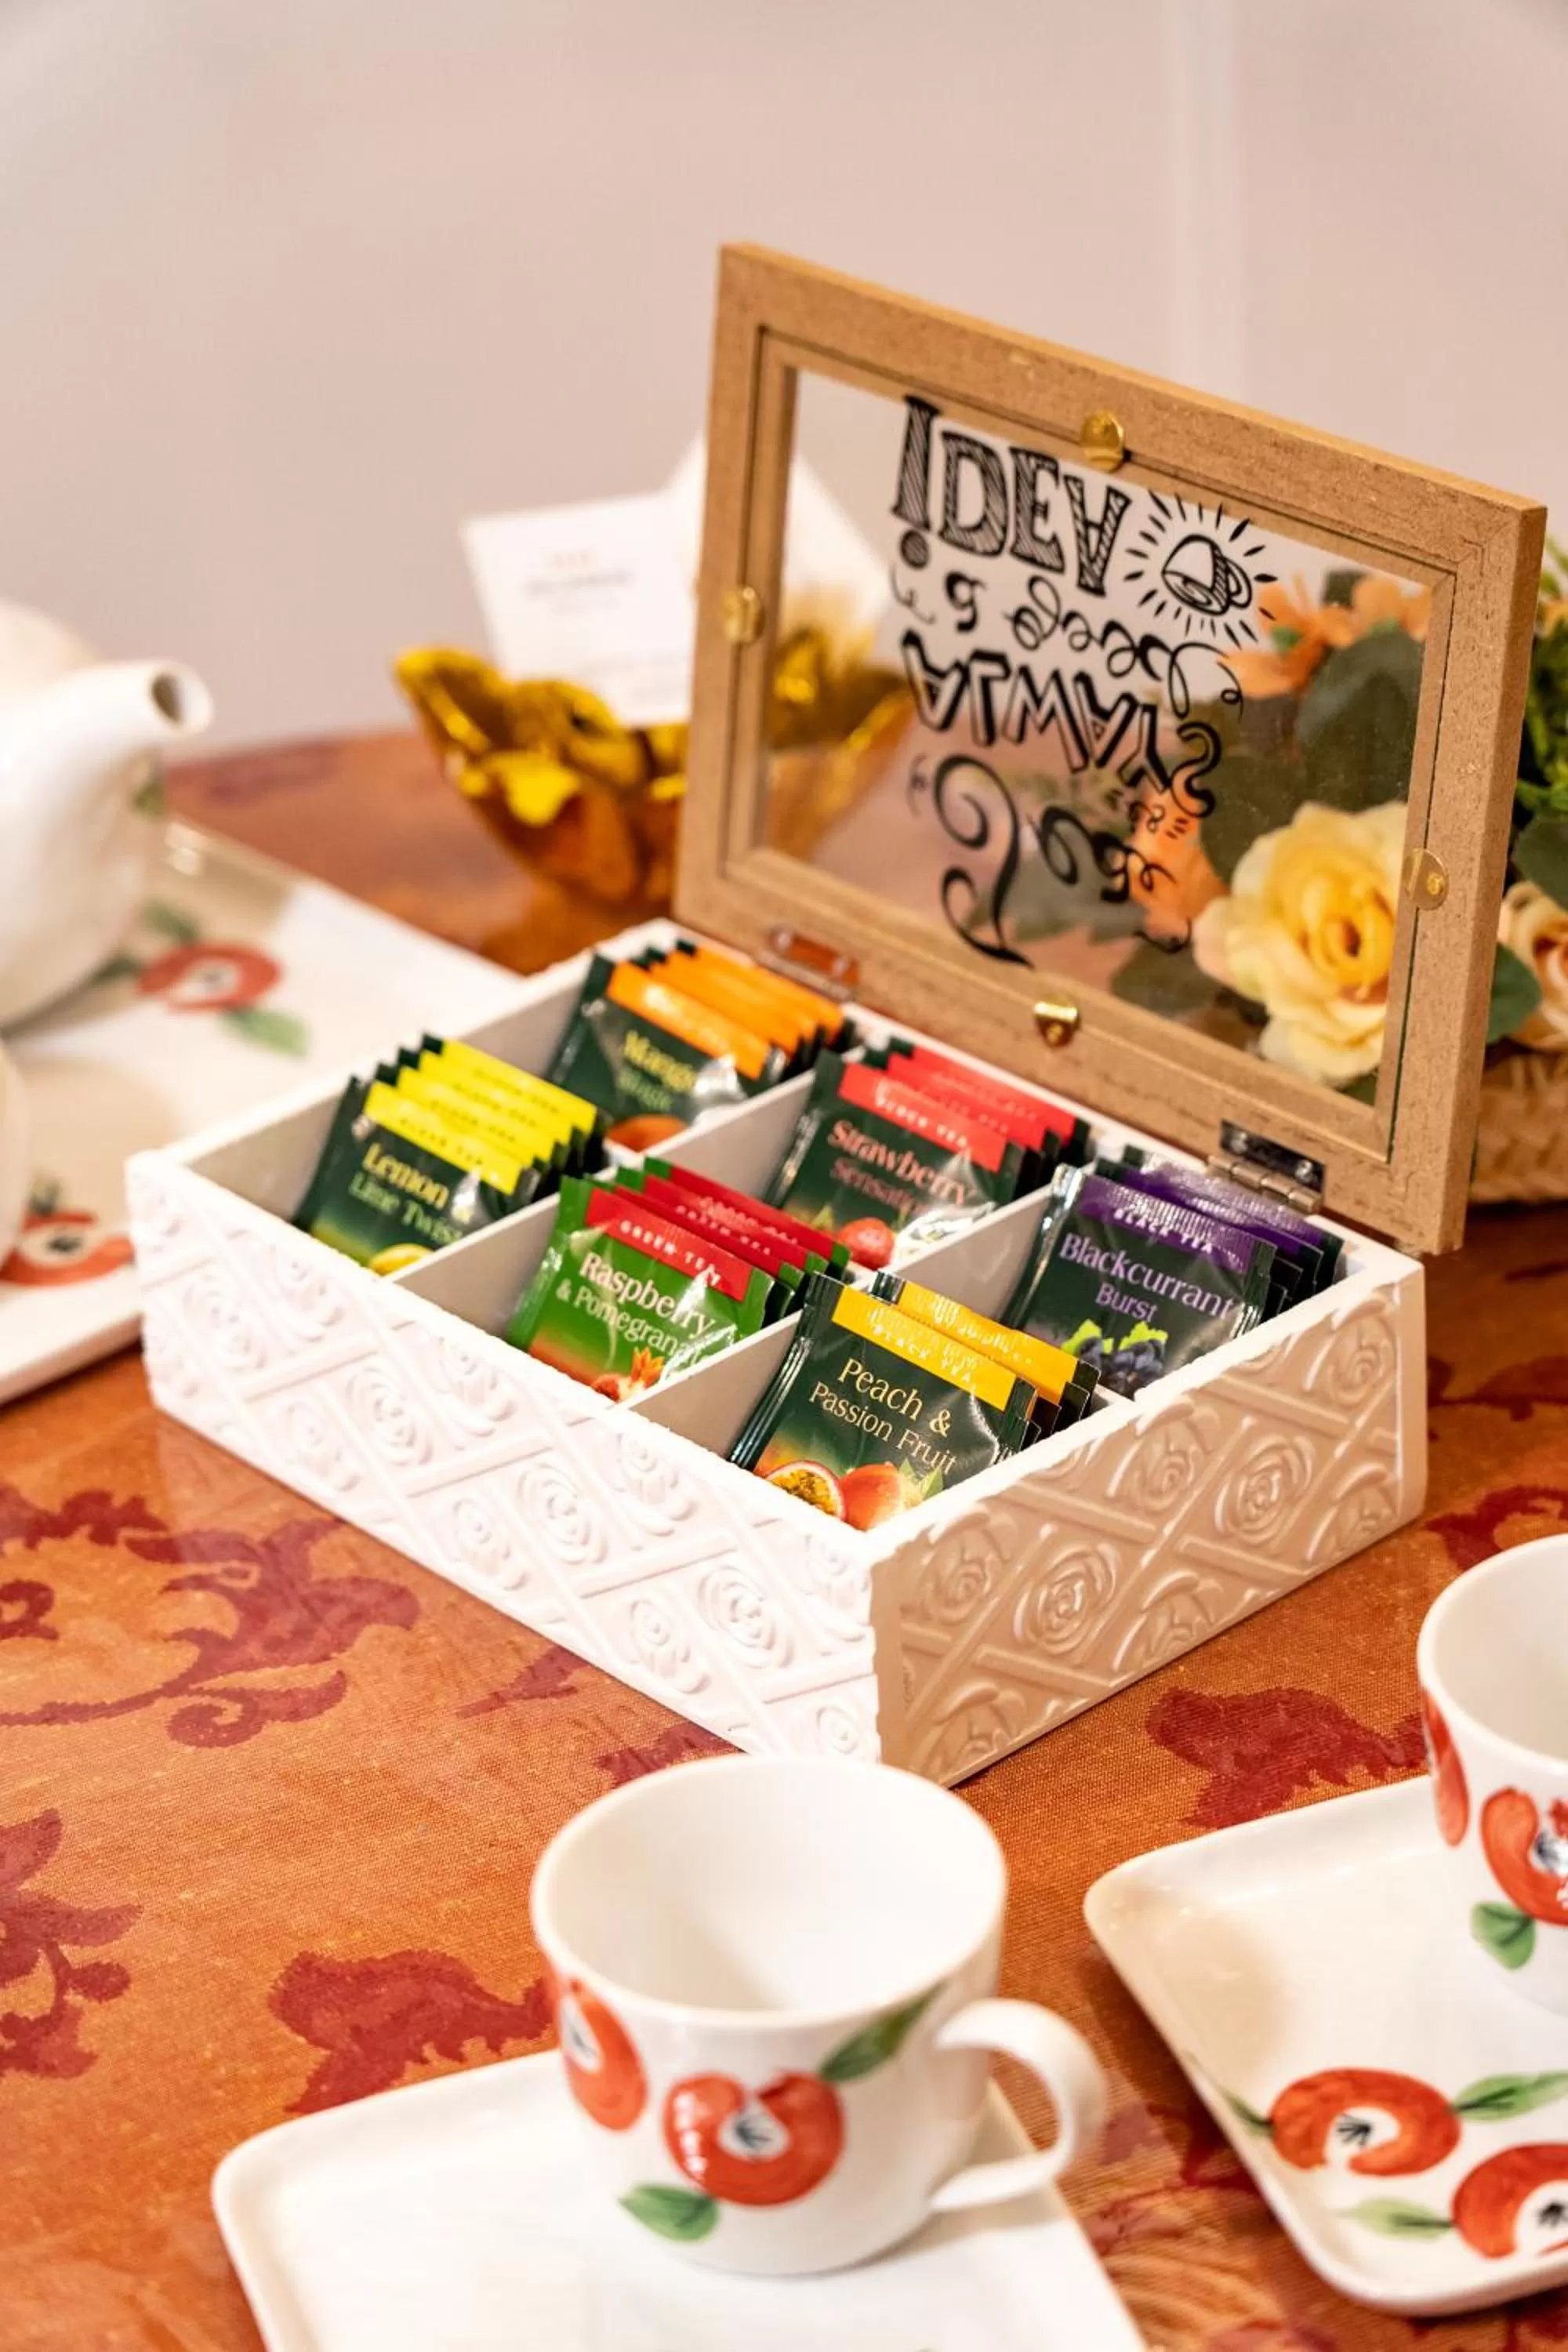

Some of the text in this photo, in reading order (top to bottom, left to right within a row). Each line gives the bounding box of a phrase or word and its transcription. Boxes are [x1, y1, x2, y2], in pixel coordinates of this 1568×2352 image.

[361, 1142, 449, 1210] Lemon
[827, 1119, 977, 1206] Strawberry
[620, 1218, 677, 1256] GREEN
[1113, 1209, 1168, 1238] BLACK
[1180, 1231, 1214, 1255] TEA
[555, 1278, 572, 1303] &
[579, 1250, 717, 1340] Raspberry
[1058, 1232, 1235, 1321] Blackcurrant
[1094, 1283, 1159, 1323] Burst
[873, 1323, 931, 1361] BLACK
[808, 1381, 958, 1476] Passion Fruit
[837, 1358, 953, 1439] Peach &
